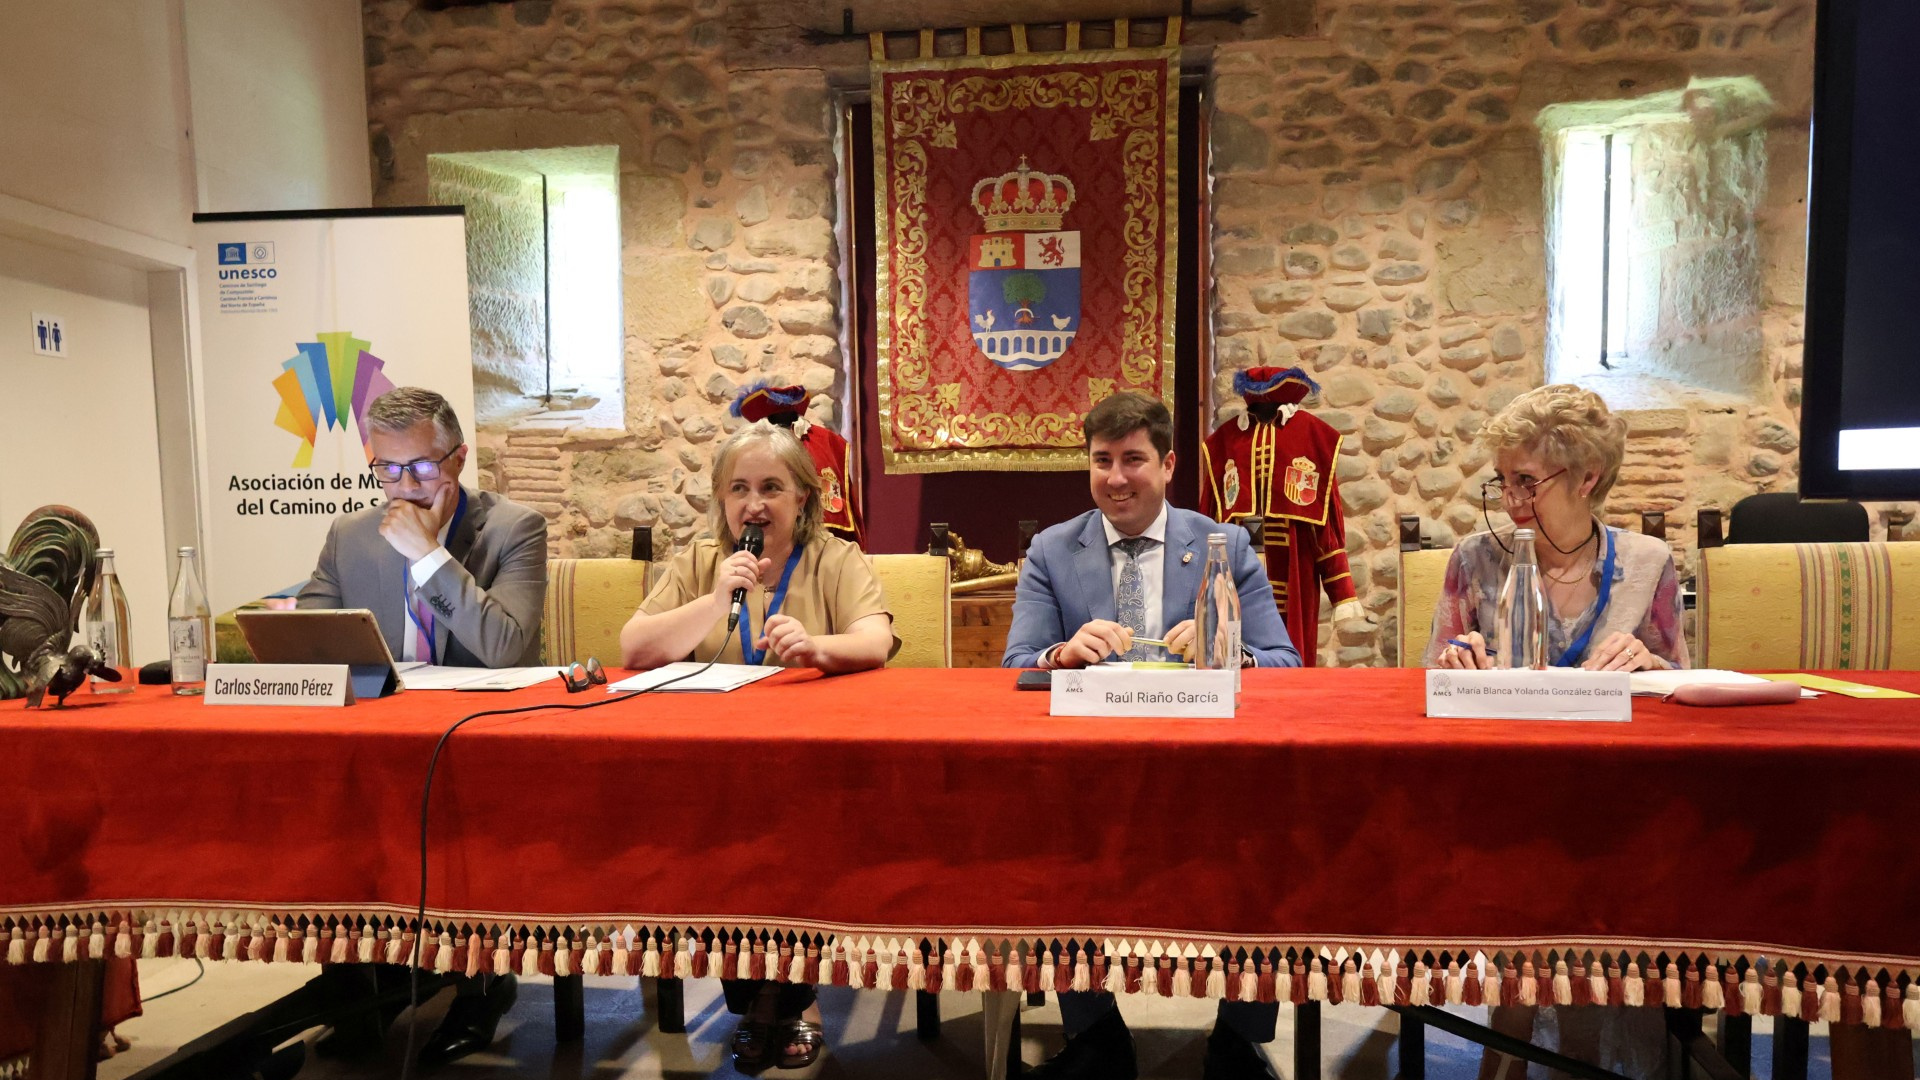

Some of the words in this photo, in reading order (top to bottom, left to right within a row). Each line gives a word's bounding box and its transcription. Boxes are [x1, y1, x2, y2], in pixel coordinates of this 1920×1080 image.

[219, 268, 277, 280] unesco
[229, 474, 324, 491] Asociación
[330, 473, 352, 490] de
[237, 499, 263, 515] del
[270, 498, 336, 515] Camino
[342, 497, 364, 513] de
[215, 678, 251, 696] Carlos
[253, 678, 298, 696] Serrano
[302, 677, 333, 696] Pérez
[1457, 687, 1481, 695] María
[1483, 687, 1512, 695] Blanca
[1515, 687, 1549, 695] Yolanda
[1551, 687, 1592, 696] González
[1594, 688, 1623, 696] García
[1105, 691, 1133, 703] Raúl
[1137, 692, 1173, 703] Riaño
[1177, 691, 1219, 703] García
